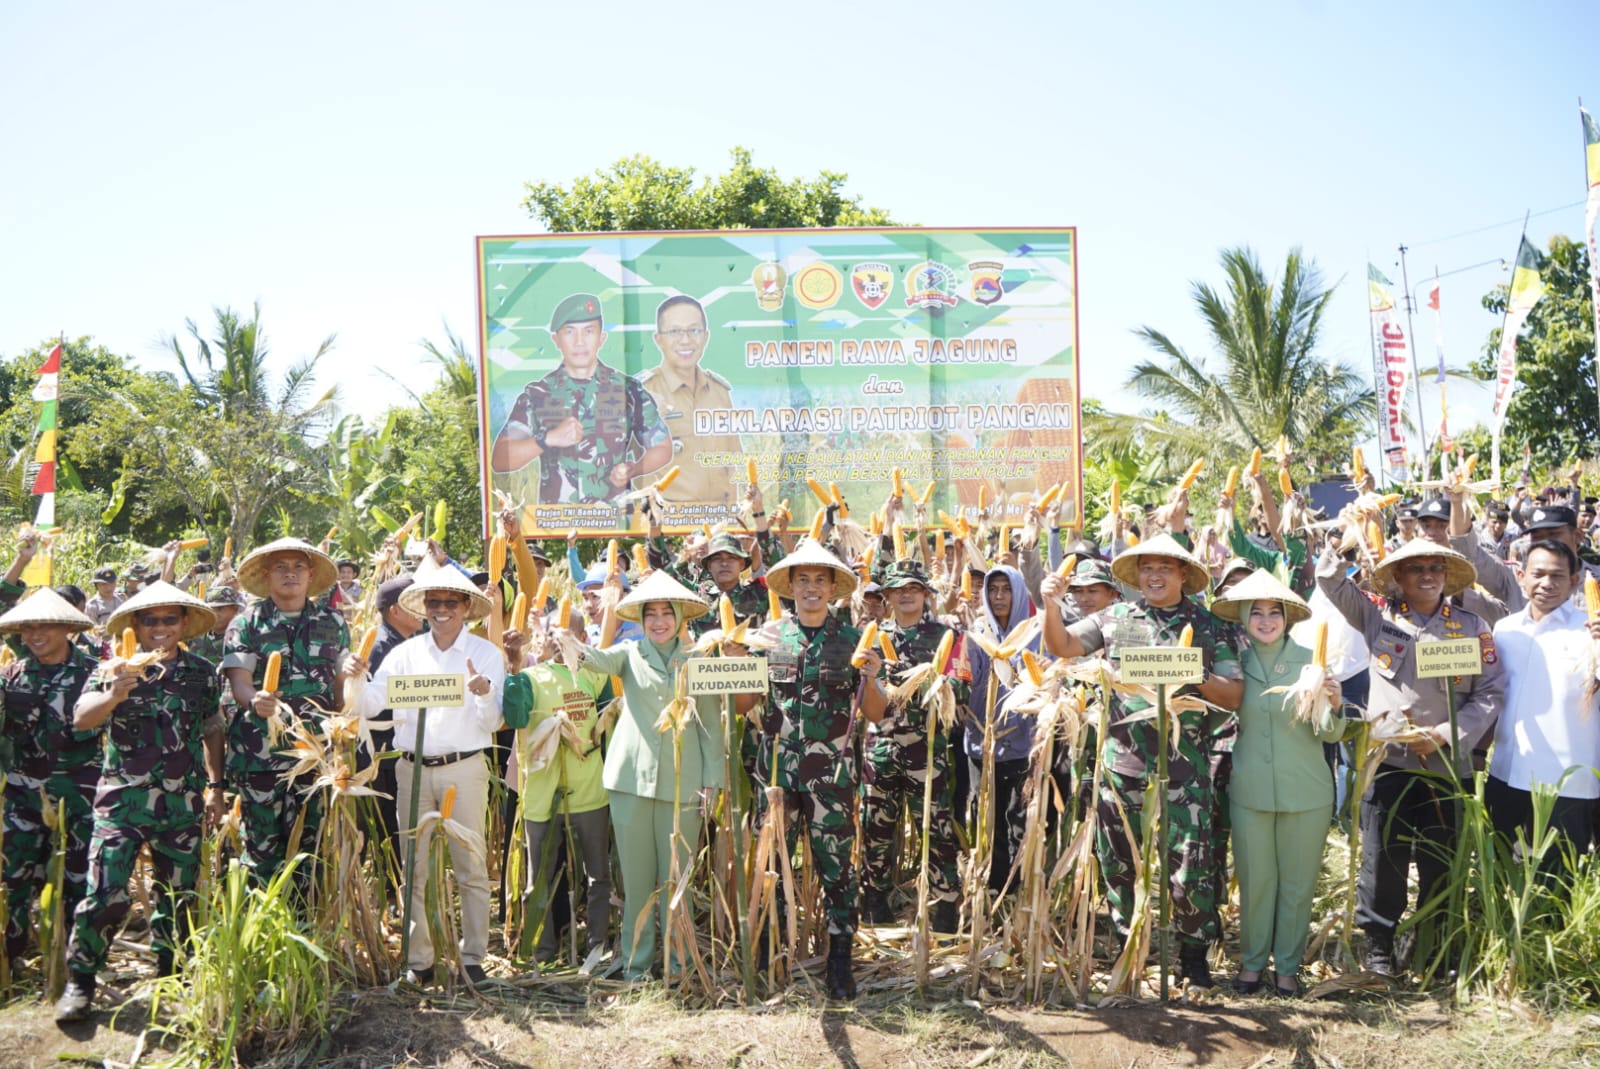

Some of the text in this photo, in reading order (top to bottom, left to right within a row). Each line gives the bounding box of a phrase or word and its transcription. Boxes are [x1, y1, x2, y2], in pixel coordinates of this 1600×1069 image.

[746, 339, 1017, 366] PANEN RAYA JAGUNG
[863, 375, 904, 394] dan
[695, 405, 1071, 434] DEKLARASI PATRIOT PANGAN
[785, 450, 880, 464] KEDAULATAN
[886, 449, 915, 461] DAN
[921, 448, 1006, 460] KETAHANAN
[1011, 447, 1070, 460] PANGAN
[851, 467, 919, 480] BERSMA
[952, 466, 981, 479] DAN
[1421, 644, 1474, 656] KAPOLRES
[1125, 653, 1198, 663] DANREM 162
[698, 663, 757, 673] PANGDAM
[1419, 662, 1478, 672] LOMBOK TIMUR
[1129, 669, 1194, 678] WIRA BHAKTI
[395, 679, 457, 690] Pj. BUPATI
[692, 680, 765, 691] IX/UDAYANA
[389, 694, 463, 703] LOMBOK TIMUR
